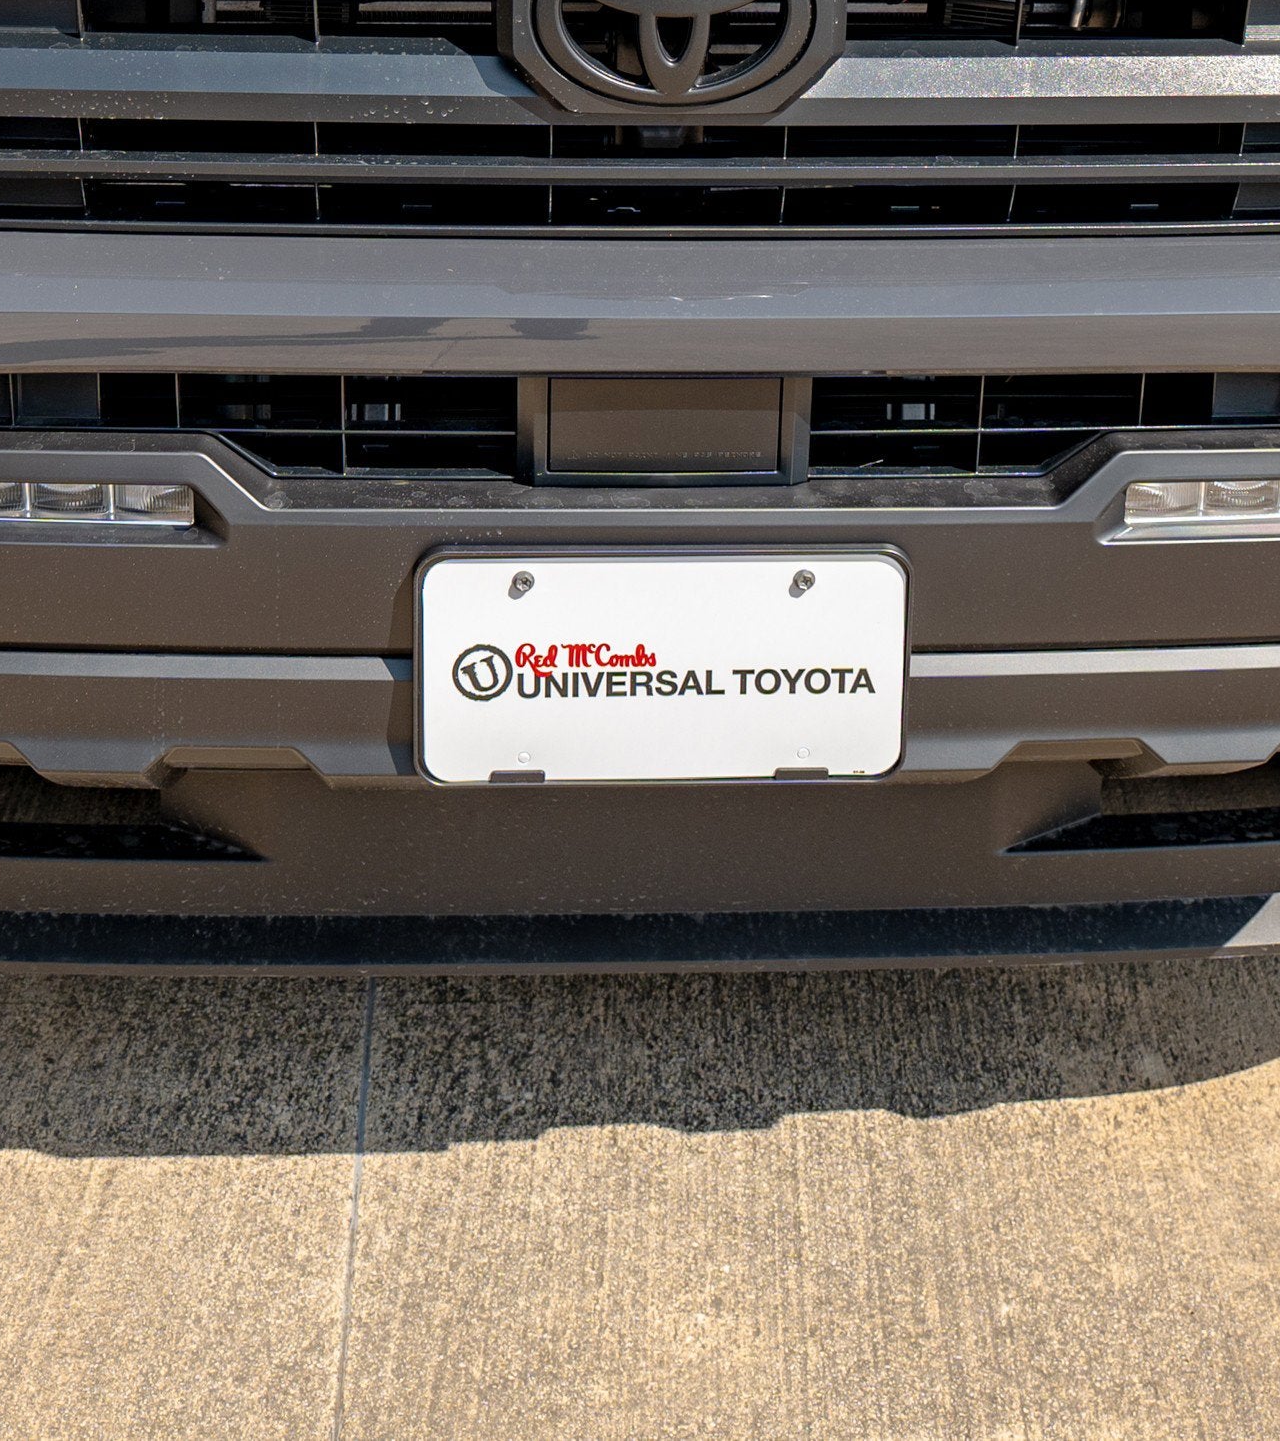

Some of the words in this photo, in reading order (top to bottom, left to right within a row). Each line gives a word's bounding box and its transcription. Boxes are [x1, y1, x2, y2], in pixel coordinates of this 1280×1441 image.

[515, 643, 559, 677] Red
[561, 643, 657, 668] McCombs
[516, 670, 725, 699] UNIVERSAL
[732, 668, 876, 696] TOYOTA
